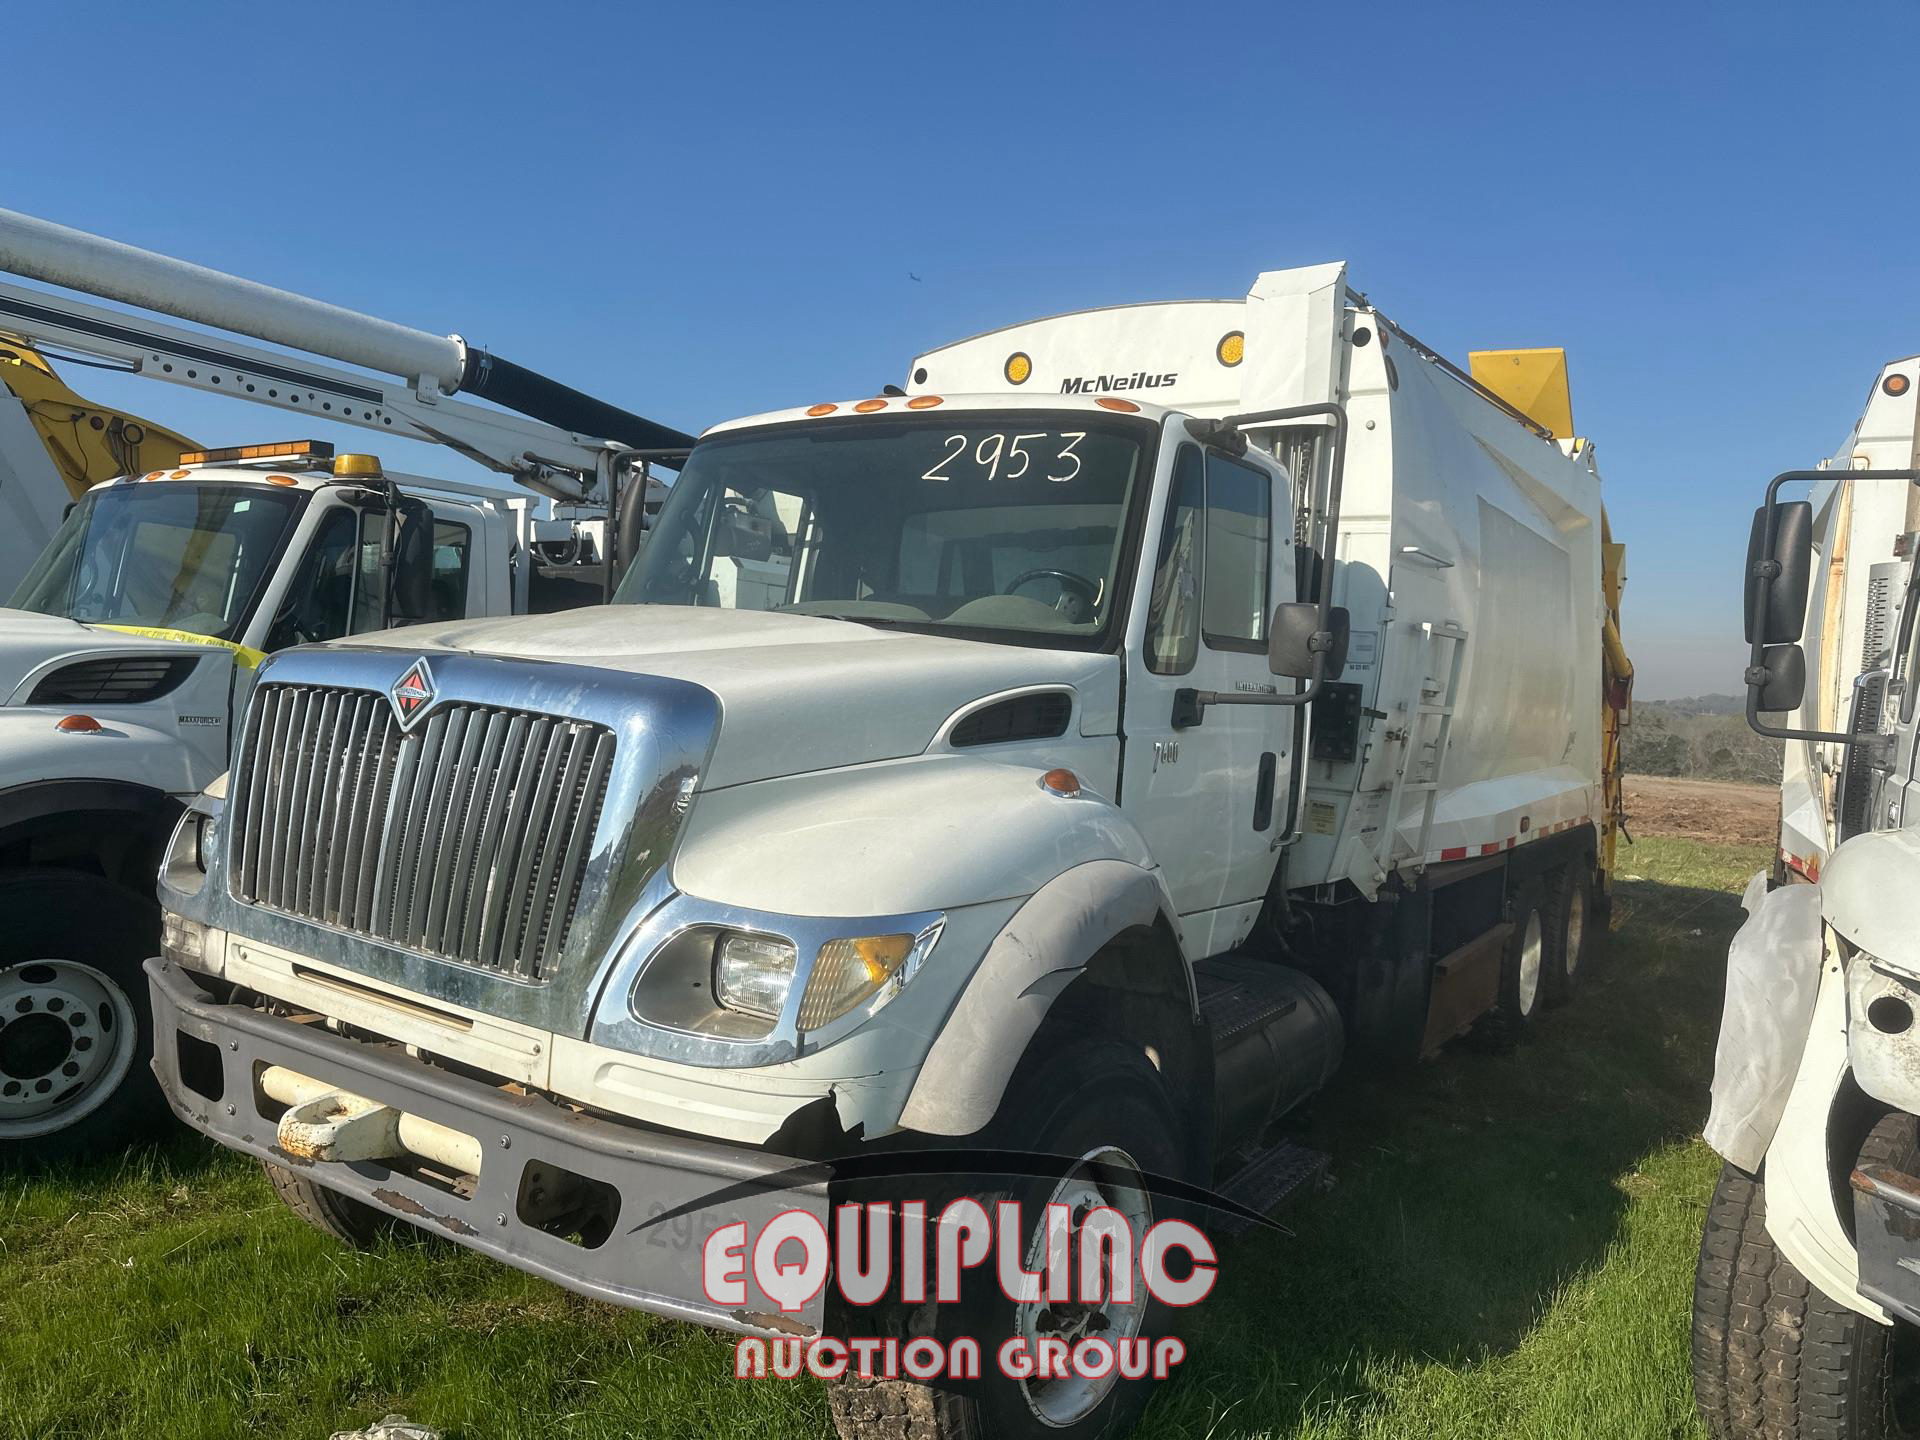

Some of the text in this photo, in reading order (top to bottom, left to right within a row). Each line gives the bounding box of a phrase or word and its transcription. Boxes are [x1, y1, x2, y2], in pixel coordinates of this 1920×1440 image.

[1060, 372, 1178, 394] McNeilus
[922, 432, 1086, 482] 2953
[1153, 742, 1179, 774] 7600
